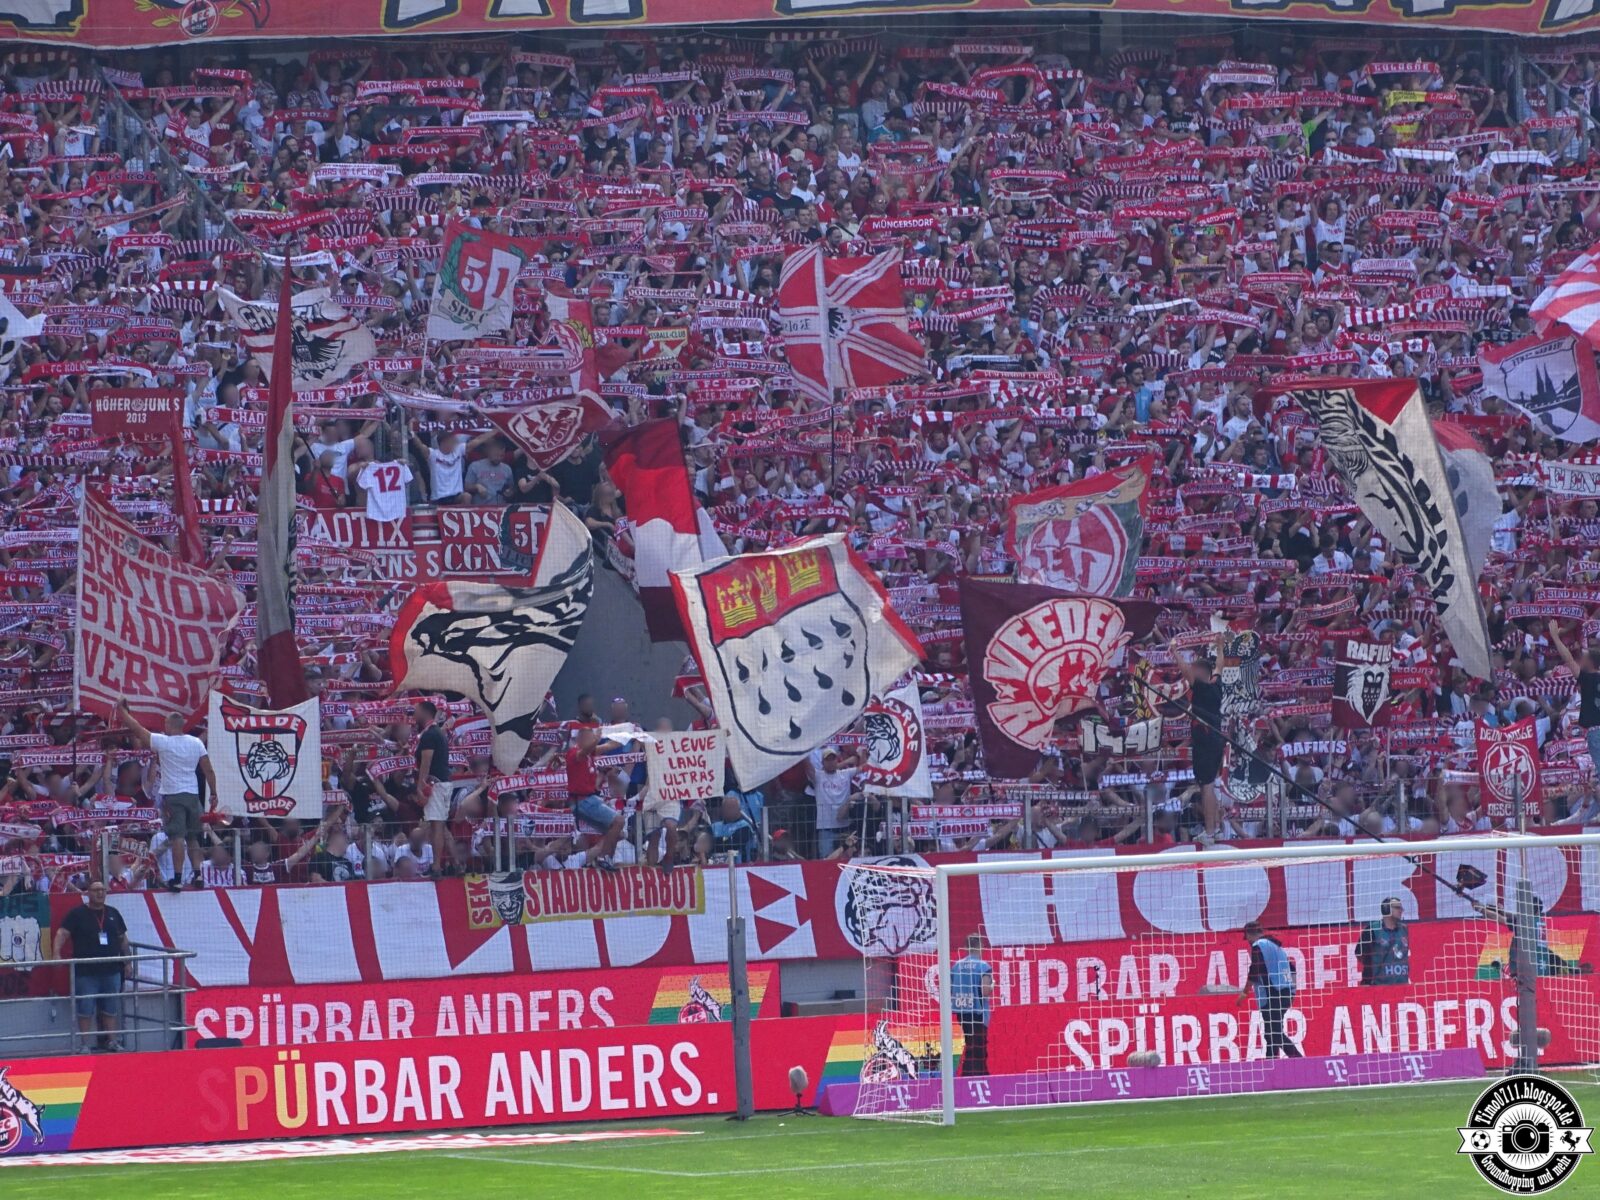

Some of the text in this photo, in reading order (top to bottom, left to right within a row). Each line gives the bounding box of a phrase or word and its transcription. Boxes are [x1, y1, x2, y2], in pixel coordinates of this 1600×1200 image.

[389, 145, 440, 155] FC KÖLN
[872, 218, 934, 231] MÜNGERSDORF
[368, 359, 413, 370] FC KÖLN
[95, 396, 131, 412] HÖHER
[126, 413, 147, 424] 2013
[230, 410, 266, 425] CHAO
[373, 466, 402, 493] 12
[442, 510, 503, 540] SPS
[444, 543, 502, 572] CGN
[82, 526, 243, 624] SEKTION
[82, 574, 220, 668] STADIO
[984, 598, 1127, 685] VEEDEL
[227, 714, 303, 734] WILDE
[1481, 728, 1504, 742] DEIN
[655, 741, 664, 755] E
[1281, 740, 1347, 757] RAFIKIS
[23, 753, 103, 766] DOUBLESEGER
[668, 755, 706, 769] LANG
[663, 769, 715, 786] ULTRAS
[659, 785, 713, 801] VUM FC
[247, 799, 294, 813] HORDE
[467, 864, 698, 926] SEK STADIONVERBOT
[977, 832, 1600, 948] HORD
[954, 995, 974, 1009] 045
[199, 1041, 718, 1133] SPÜRBAR ANDERS.
